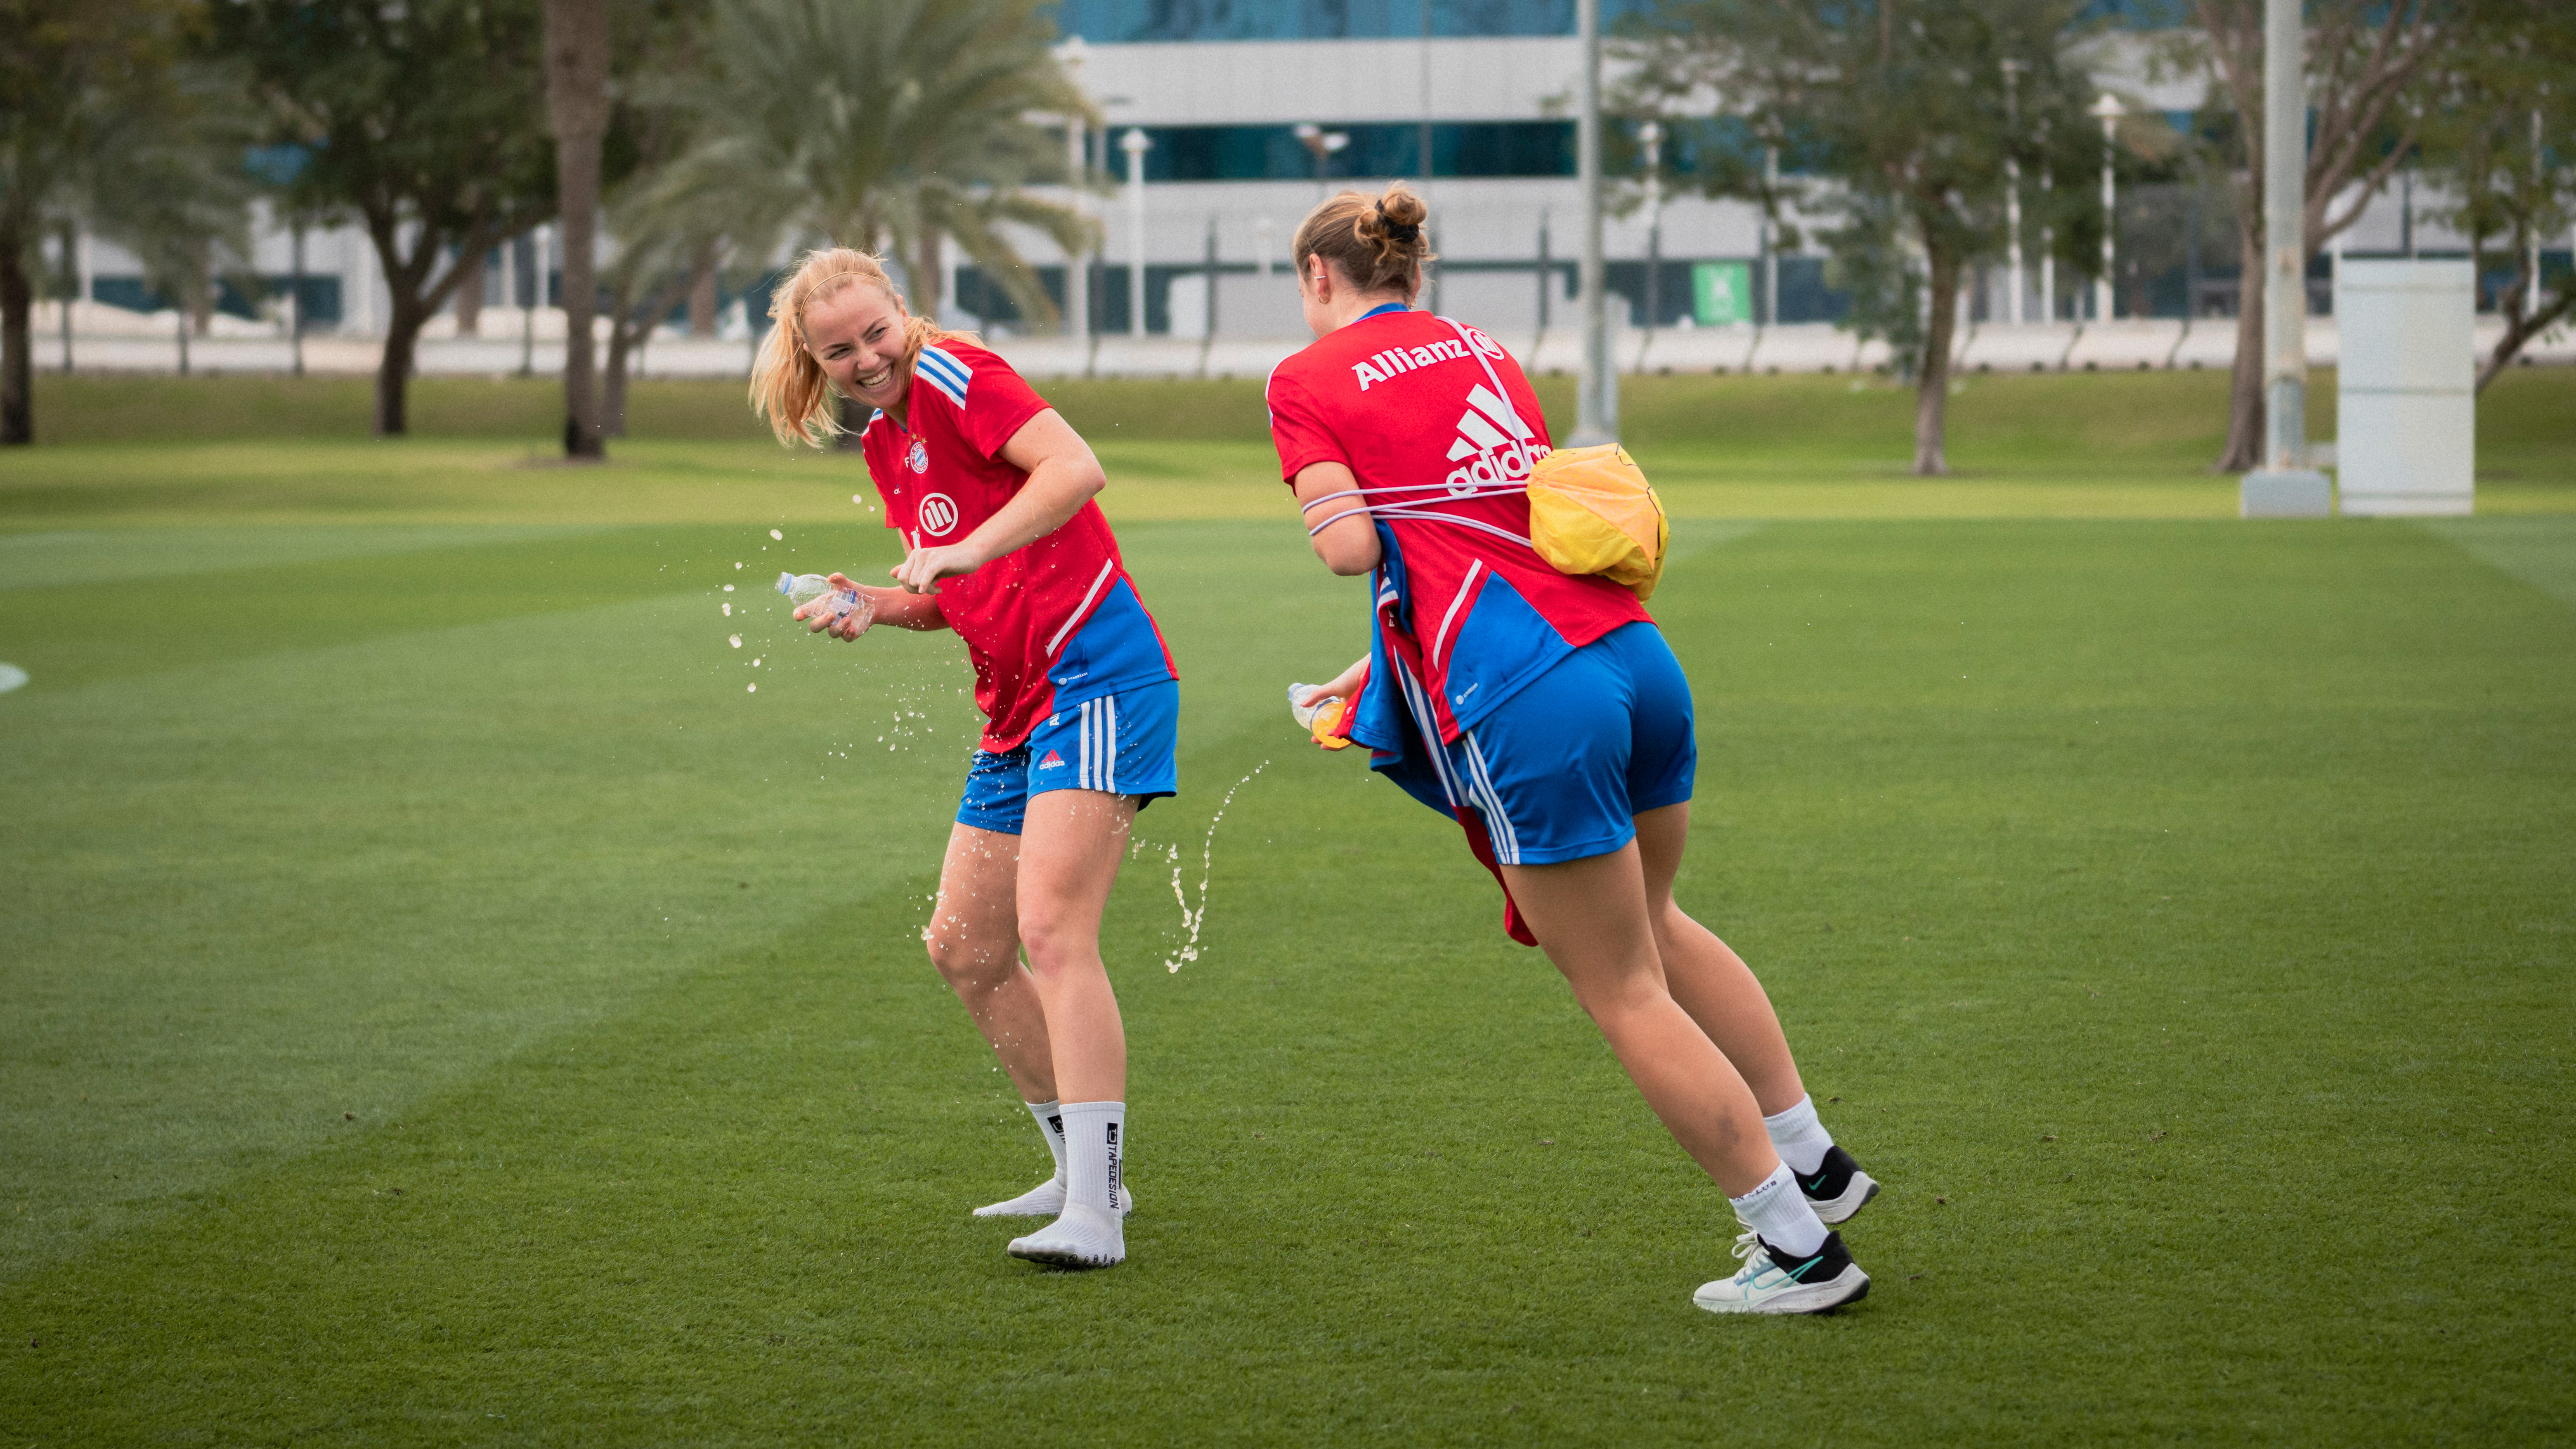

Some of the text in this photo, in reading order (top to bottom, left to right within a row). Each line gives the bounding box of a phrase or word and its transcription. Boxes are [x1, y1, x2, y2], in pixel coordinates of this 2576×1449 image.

[1352, 339, 1471, 392] Allianz
[1040, 760, 1065, 770] adidas
[1108, 1146, 1120, 1210] TAPEDESIGN
